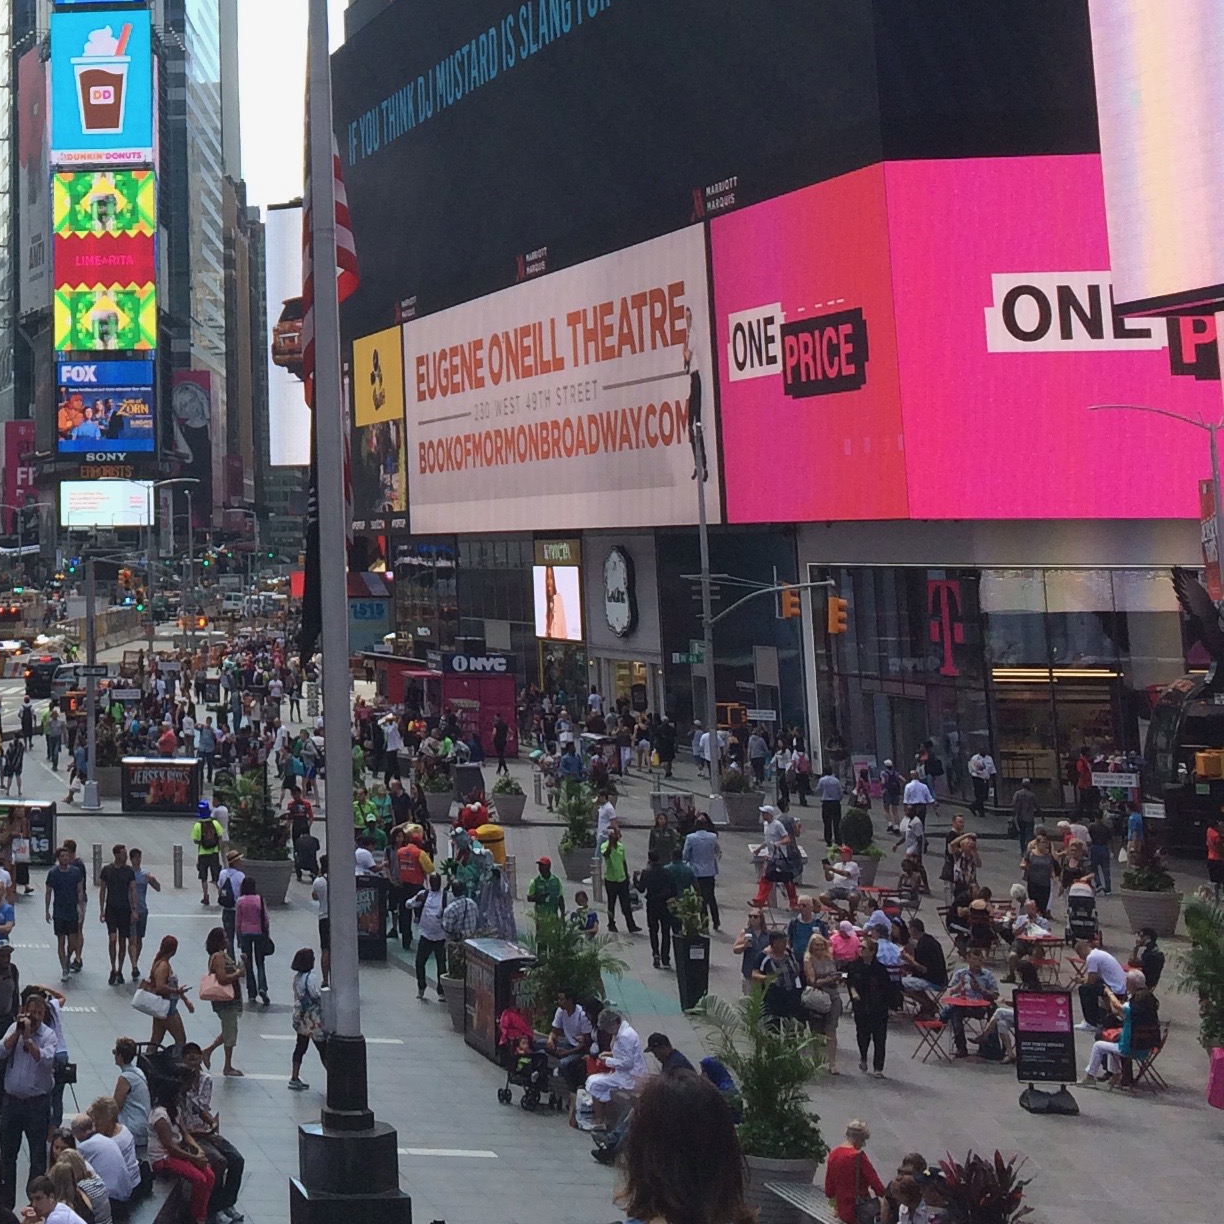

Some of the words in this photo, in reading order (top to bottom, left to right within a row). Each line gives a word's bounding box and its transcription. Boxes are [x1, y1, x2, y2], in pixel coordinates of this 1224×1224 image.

[348, 120, 358, 167] IF
[359, 102, 380, 160] YOU
[381, 81, 417, 145] THINK
[417, 68, 434, 124] DJ
[435, 26, 499, 112] MUSTARD
[501, 14, 516, 72] IS
[105, 151, 142, 159] DONUTS
[705, 176, 738, 197] MARRIOTT
[706, 192, 736, 211] MARQUIS
[416, 333, 486, 403] EUGENE
[487, 317, 565, 386] O'NEILL
[566, 281, 688, 368] THEATRE
[732, 315, 778, 372] ONE
[783, 323, 856, 385] PRICE
[61, 365, 98, 383] FOX
[116, 402, 150, 417] ZORN
[473, 401, 492, 422] 230
[494, 395, 521, 417] WEST
[526, 388, 552, 411] 49TH
[556, 379, 599, 407] STREET
[418, 399, 690, 476] BOOKOFMORMONBROADWAY.COM
[86, 453, 127, 462] SONY
[470, 656, 507, 672] NYC
[130, 770, 165, 785] JERSEY
